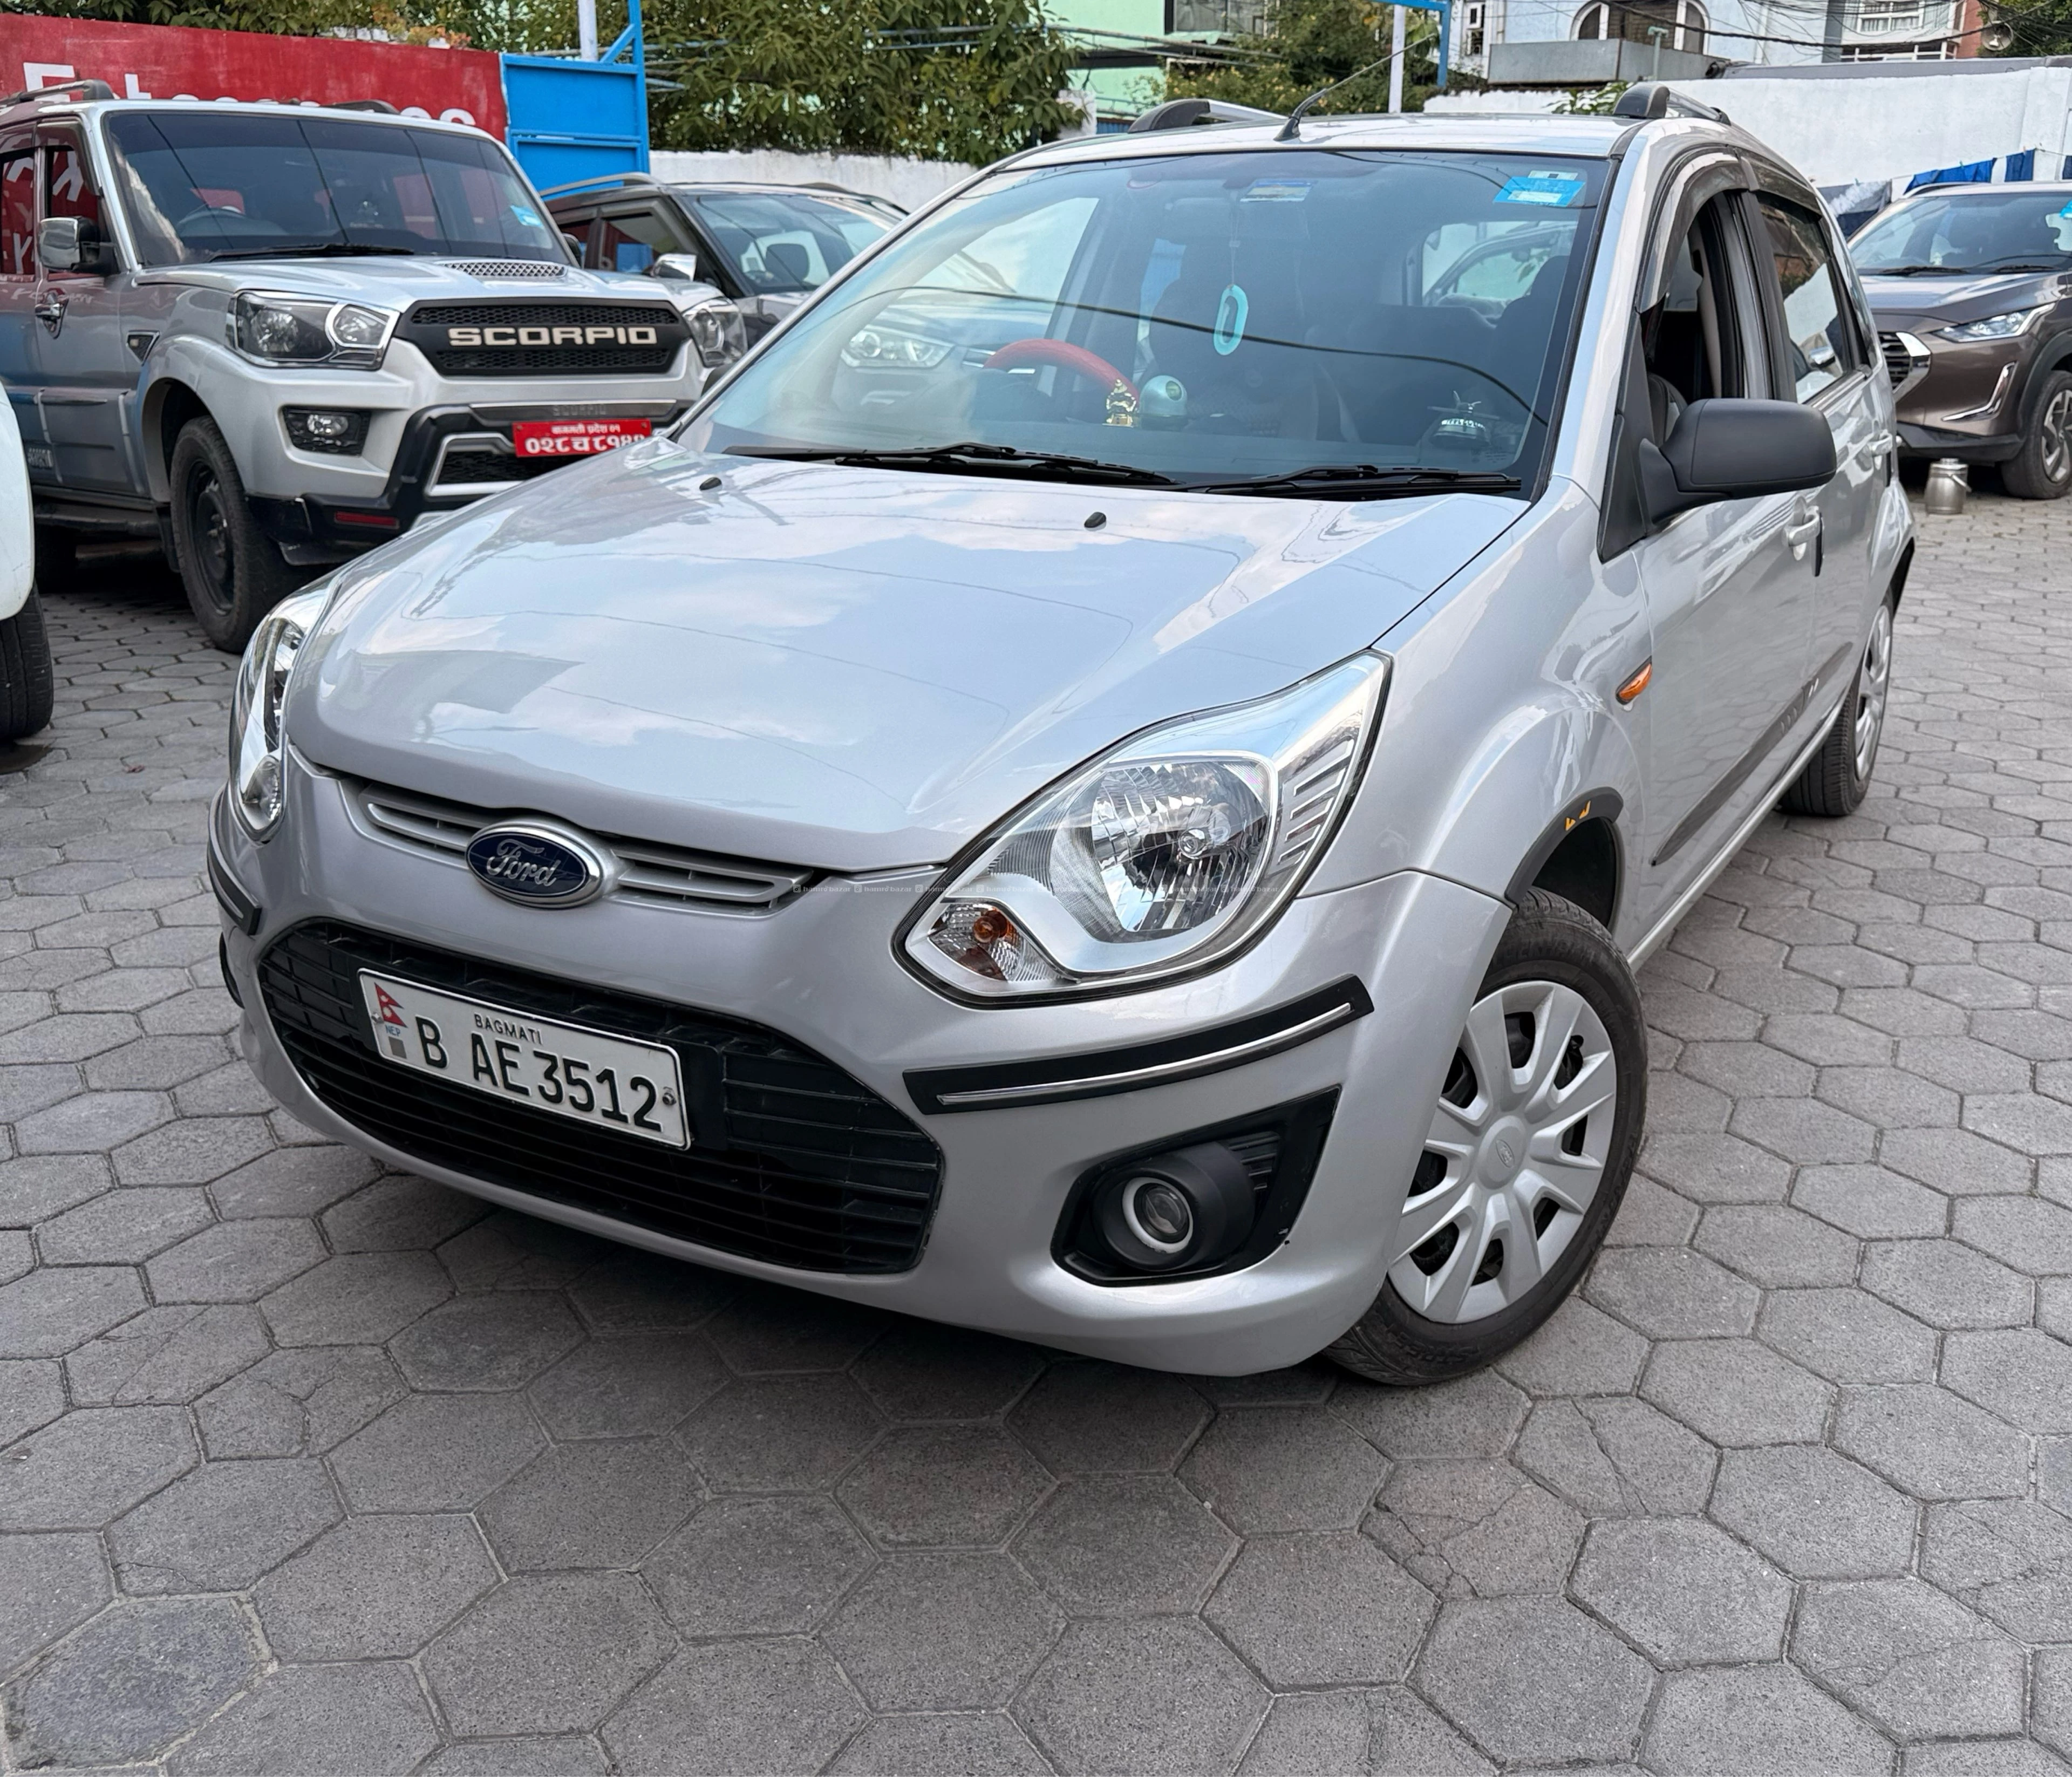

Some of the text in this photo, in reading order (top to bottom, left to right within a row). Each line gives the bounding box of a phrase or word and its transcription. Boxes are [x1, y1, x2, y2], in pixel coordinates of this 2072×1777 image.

[448, 327, 657, 346] SCORPIO
[487, 839, 561, 887] Ford
[385, 1025, 400, 1036] NEP
[474, 1013, 542, 1044] BAGMATI
[415, 1016, 662, 1132] B AE3512
